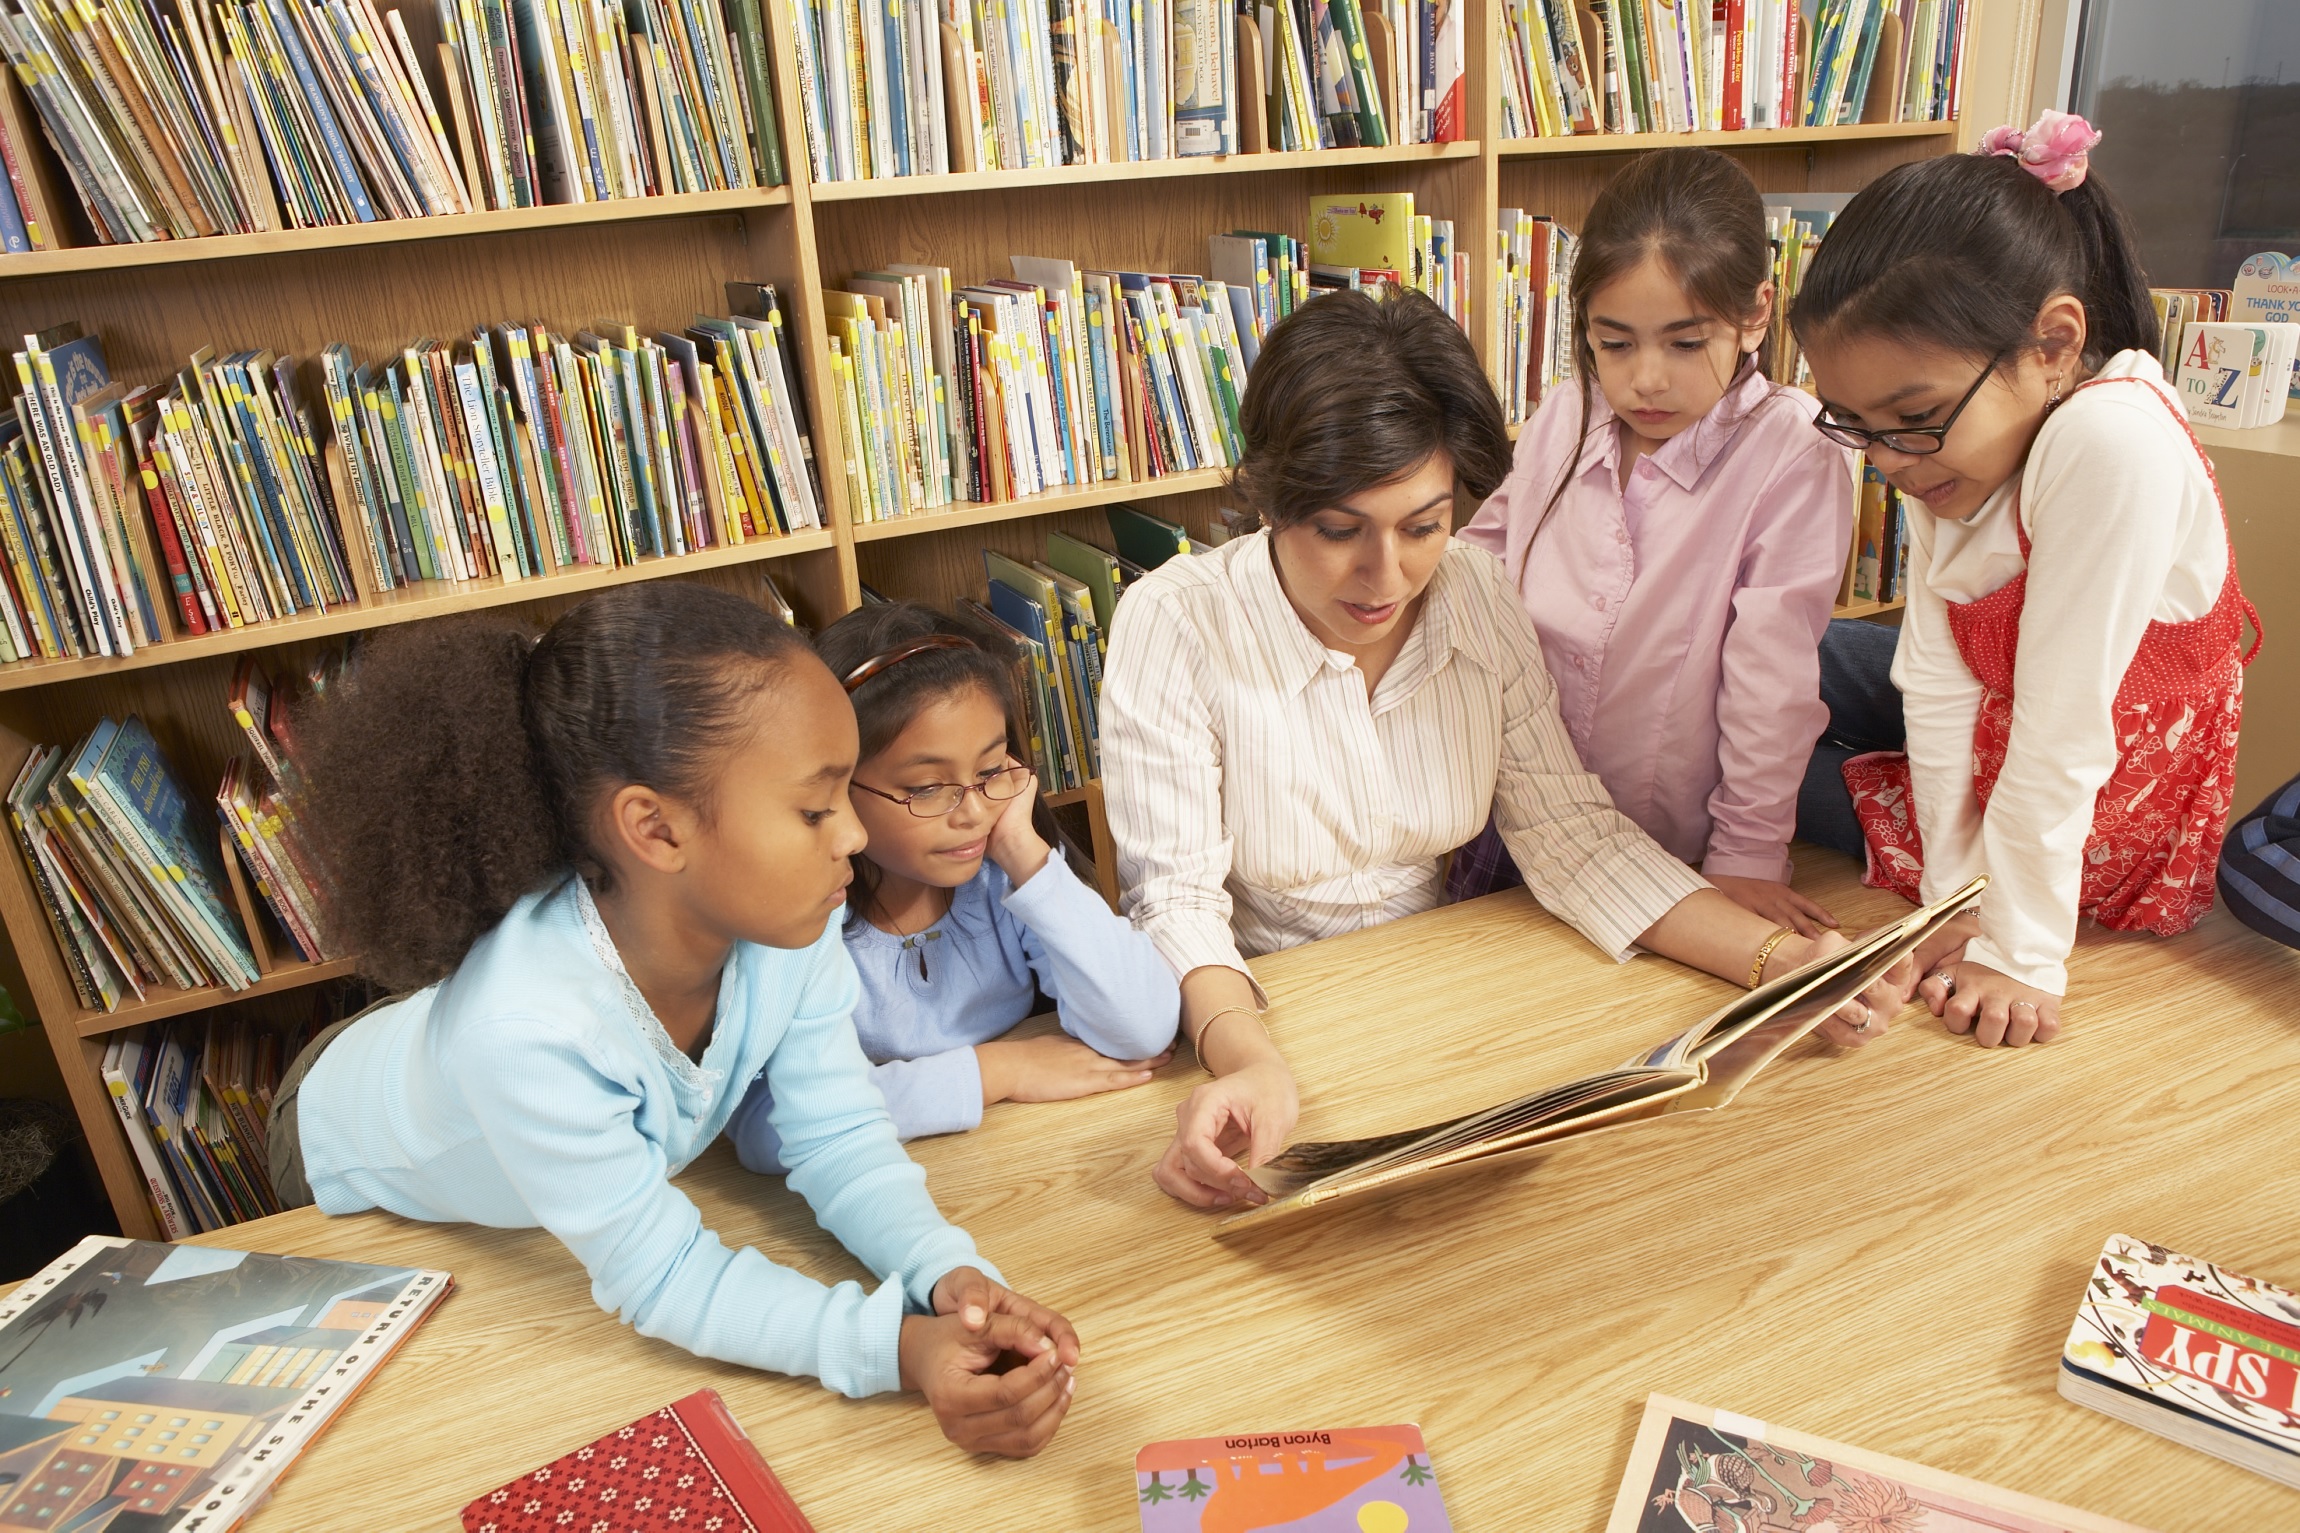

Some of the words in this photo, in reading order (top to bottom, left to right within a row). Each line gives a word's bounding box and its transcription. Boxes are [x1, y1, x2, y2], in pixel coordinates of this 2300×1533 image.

[487, 6, 497, 40] PHONICS
[1636, 0, 1645, 36] OUNTING
[1641, 39, 1649, 61] BOOK
[296, 55, 306, 71] Clark
[497, 51, 507, 78] There's
[1210, 52, 1220, 101] Behave!
[103, 40, 120, 64] ANDY
[124, 80, 151, 125] CHANDLER
[503, 88, 513, 118] dragon
[307, 82, 328, 121] FRANKLIN'S
[324, 122, 339, 149] SCHOOL
[335, 149, 354, 184] TREASURY
[510, 129, 517, 140] my
[512, 143, 522, 173] wagon!
[236, 157, 246, 177] NATIONAL
[243, 178, 255, 205] GEOGRAPHIC
[1259, 289, 1267, 307] Second
[2246, 297, 2285, 310] THANK
[2265, 311, 2289, 323] GOD
[2183, 329, 2211, 370] A
[540, 352, 550, 382] GRANDPAS
[547, 383, 552, 392] DO
[564, 356, 573, 378] Calico
[413, 383, 421, 398] The
[461, 377, 474, 397] The
[537, 382, 546, 396] MY
[568, 381, 576, 393] Cat
[650, 360, 658, 379] DAVID
[655, 393, 665, 420] GOLIATH
[2186, 377, 2206, 395] TO
[2205, 367, 2241, 409] Z
[27, 390, 40, 417] THERE
[416, 399, 423, 411] Me
[466, 399, 480, 422] Lion
[540, 397, 551, 420] BEST
[571, 397, 580, 416] Meets
[718, 391, 730, 411] NOODLE
[35, 419, 46, 438] WAS
[49, 386, 57, 398] This
[58, 416, 67, 432] house
[63, 435, 71, 448] that
[71, 464, 79, 478] built
[537, 426, 542, 434] DO
[545, 420, 558, 453] FRIEND
[576, 420, 587, 453] Bookworm
[1104, 421, 1113, 456] Berenstains
[41, 439, 50, 452] AN
[472, 423, 492, 473] Storyteller
[45, 453, 55, 470] OLD
[619, 448, 629, 472] WALSH
[50, 472, 62, 493] LADY
[394, 452, 402, 464] AND
[398, 465, 406, 482] OTHER
[402, 483, 412, 505] STORIES
[484, 476, 499, 503] Bible
[184, 471, 196, 492] SHOW
[194, 500, 204, 515] TELL
[199, 516, 209, 531] DAY
[3, 512, 12, 522] MY
[164, 482, 173, 500] WHAT
[170, 501, 181, 522] MAKES
[180, 528, 189, 543] BIRD
[187, 550, 197, 567] BIRD?
[202, 482, 216, 511] LITTLE
[213, 513, 227, 541] BLACK,
[225, 551, 237, 572] PONY
[560, 498, 571, 525] Regina
[566, 526, 576, 548] Press
[7, 523, 17, 539] FIRST
[13, 540, 25, 563] SONGS
[85, 588, 95, 609] Child's
[90, 611, 99, 626] Play
[111, 598, 119, 615] Child's
[1048, 592, 1056, 605] PUSS
[1051, 604, 1057, 612] IN
[1052, 612, 1061, 631] BOOTS
[246, 726, 265, 751] SQUIRREL
[261, 750, 277, 769] TWINS
[102, 800, 122, 825] CARL'S
[121, 825, 153, 866] CHRISTMAS
[109, 786, 119, 797] The
[115, 795, 127, 807] Fish
[123, 805, 134, 817] Who
[130, 814, 145, 831] Could
[141, 829, 152, 840] Wish
[152, 842, 163, 855] John
[250, 850, 259, 862] THE
[256, 862, 267, 876] SILLY
[277, 898, 289, 914] BOOK
[149, 1177, 165, 1205] QUESTIONS
[162, 1208, 178, 1234] ANSWERS
[167, 1203, 175, 1216] BOOK
[362, 1275, 434, 1345] RETURN
[2147, 1300, 2250, 1343] ANIMALS
[334, 1353, 360, 1378] OF
[2154, 1324, 2270, 1400] SPY
[286, 1385, 331, 1425] THE
[1225, 1435, 1281, 1450] Barton
[1284, 1432, 1331, 1446] Byron
[184, 1434, 285, 1533] SHADOW
